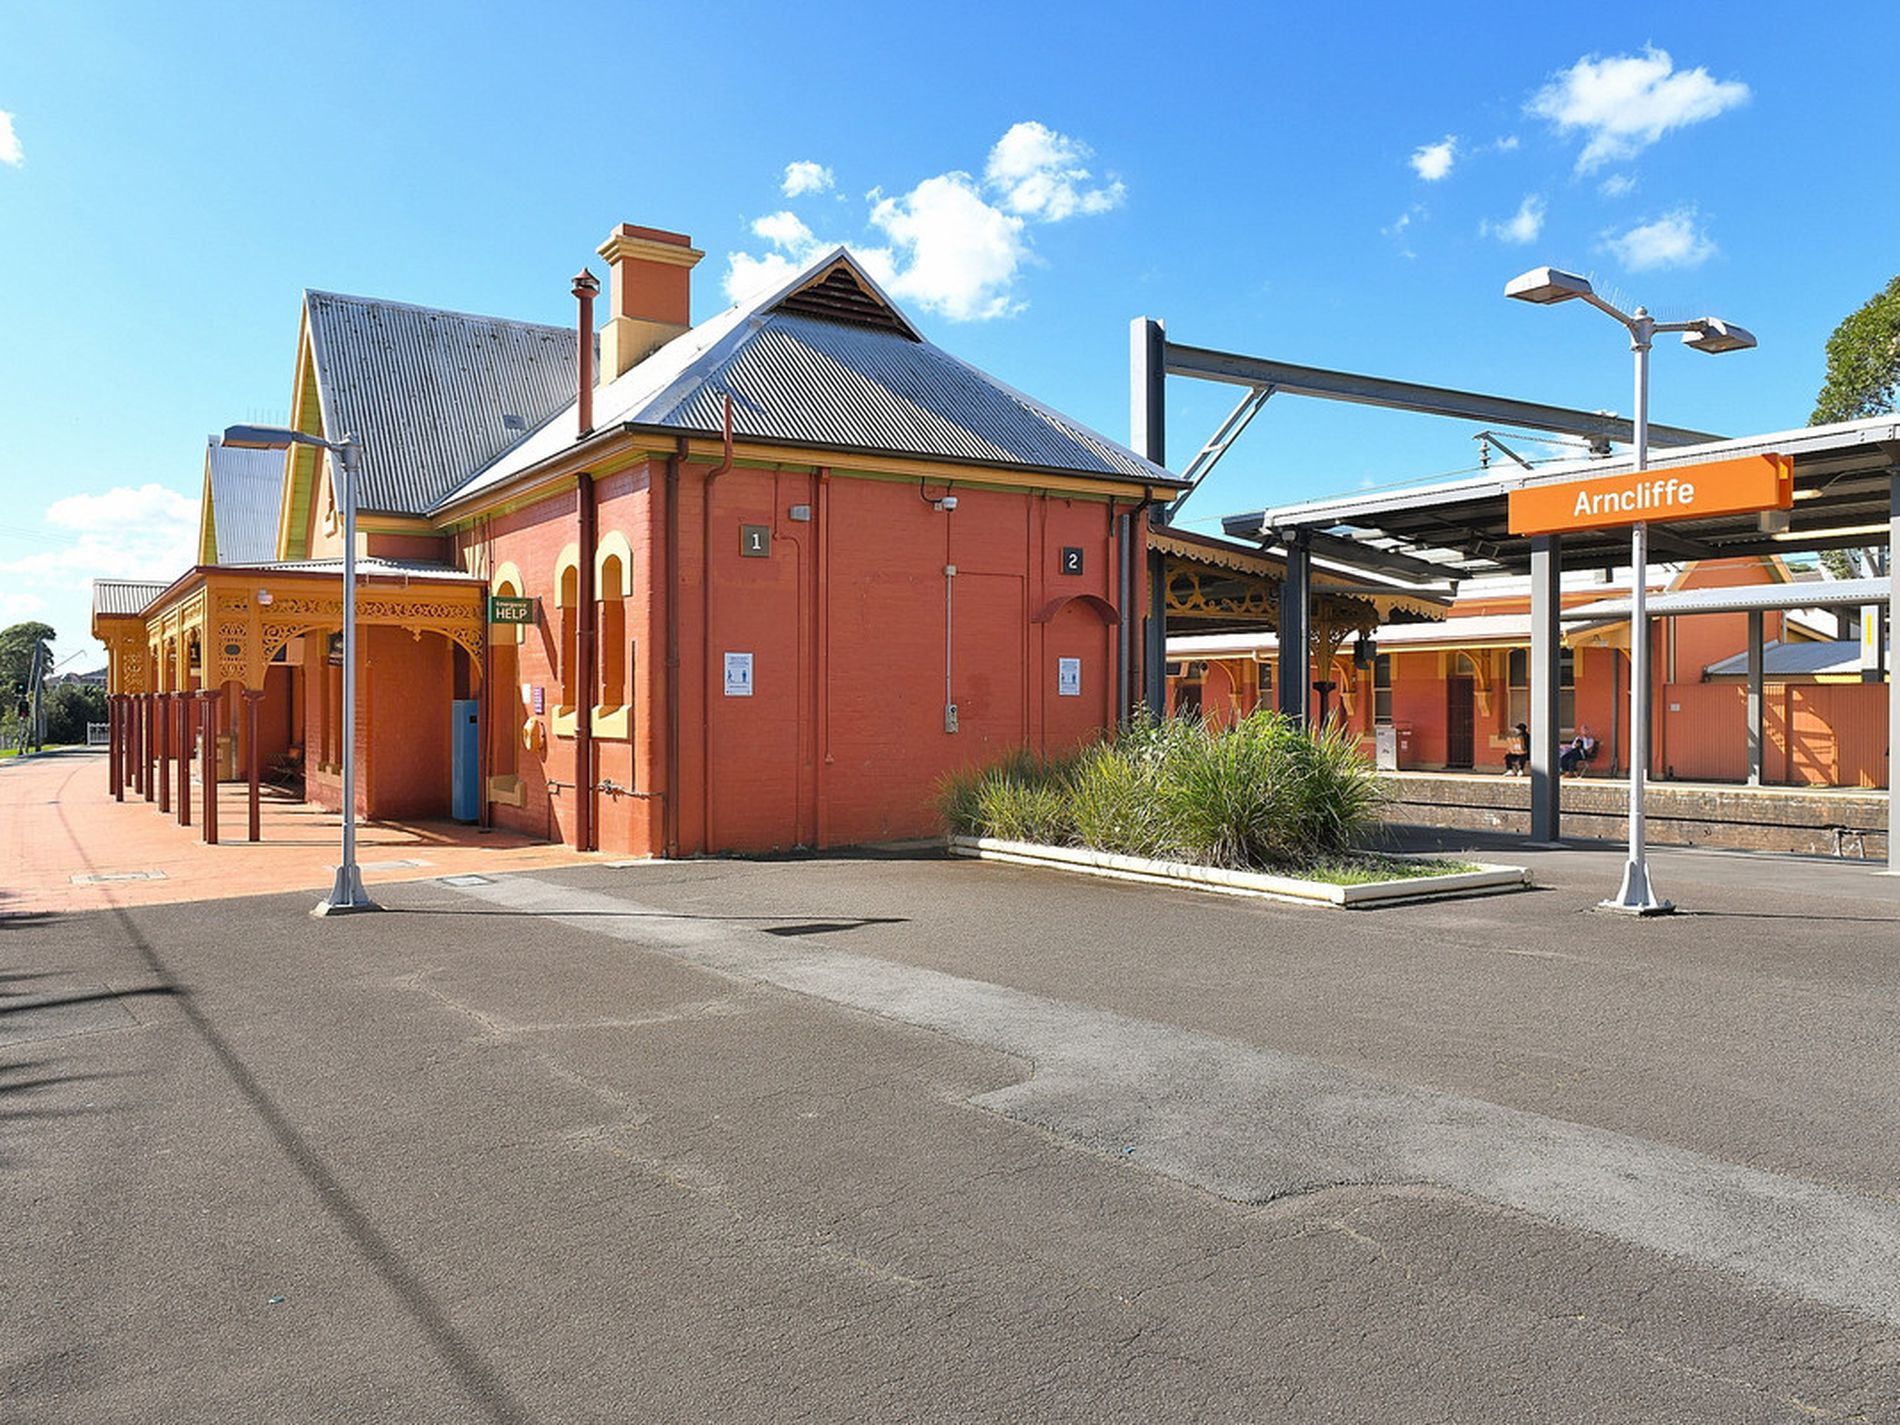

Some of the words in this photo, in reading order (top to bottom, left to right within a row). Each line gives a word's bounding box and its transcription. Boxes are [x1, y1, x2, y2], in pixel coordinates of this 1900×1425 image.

[1573, 478, 1695, 517] Arncliffe
[752, 533, 761, 550] 1
[1069, 553, 1078, 569] 2
[496, 607, 528, 619] HELP
